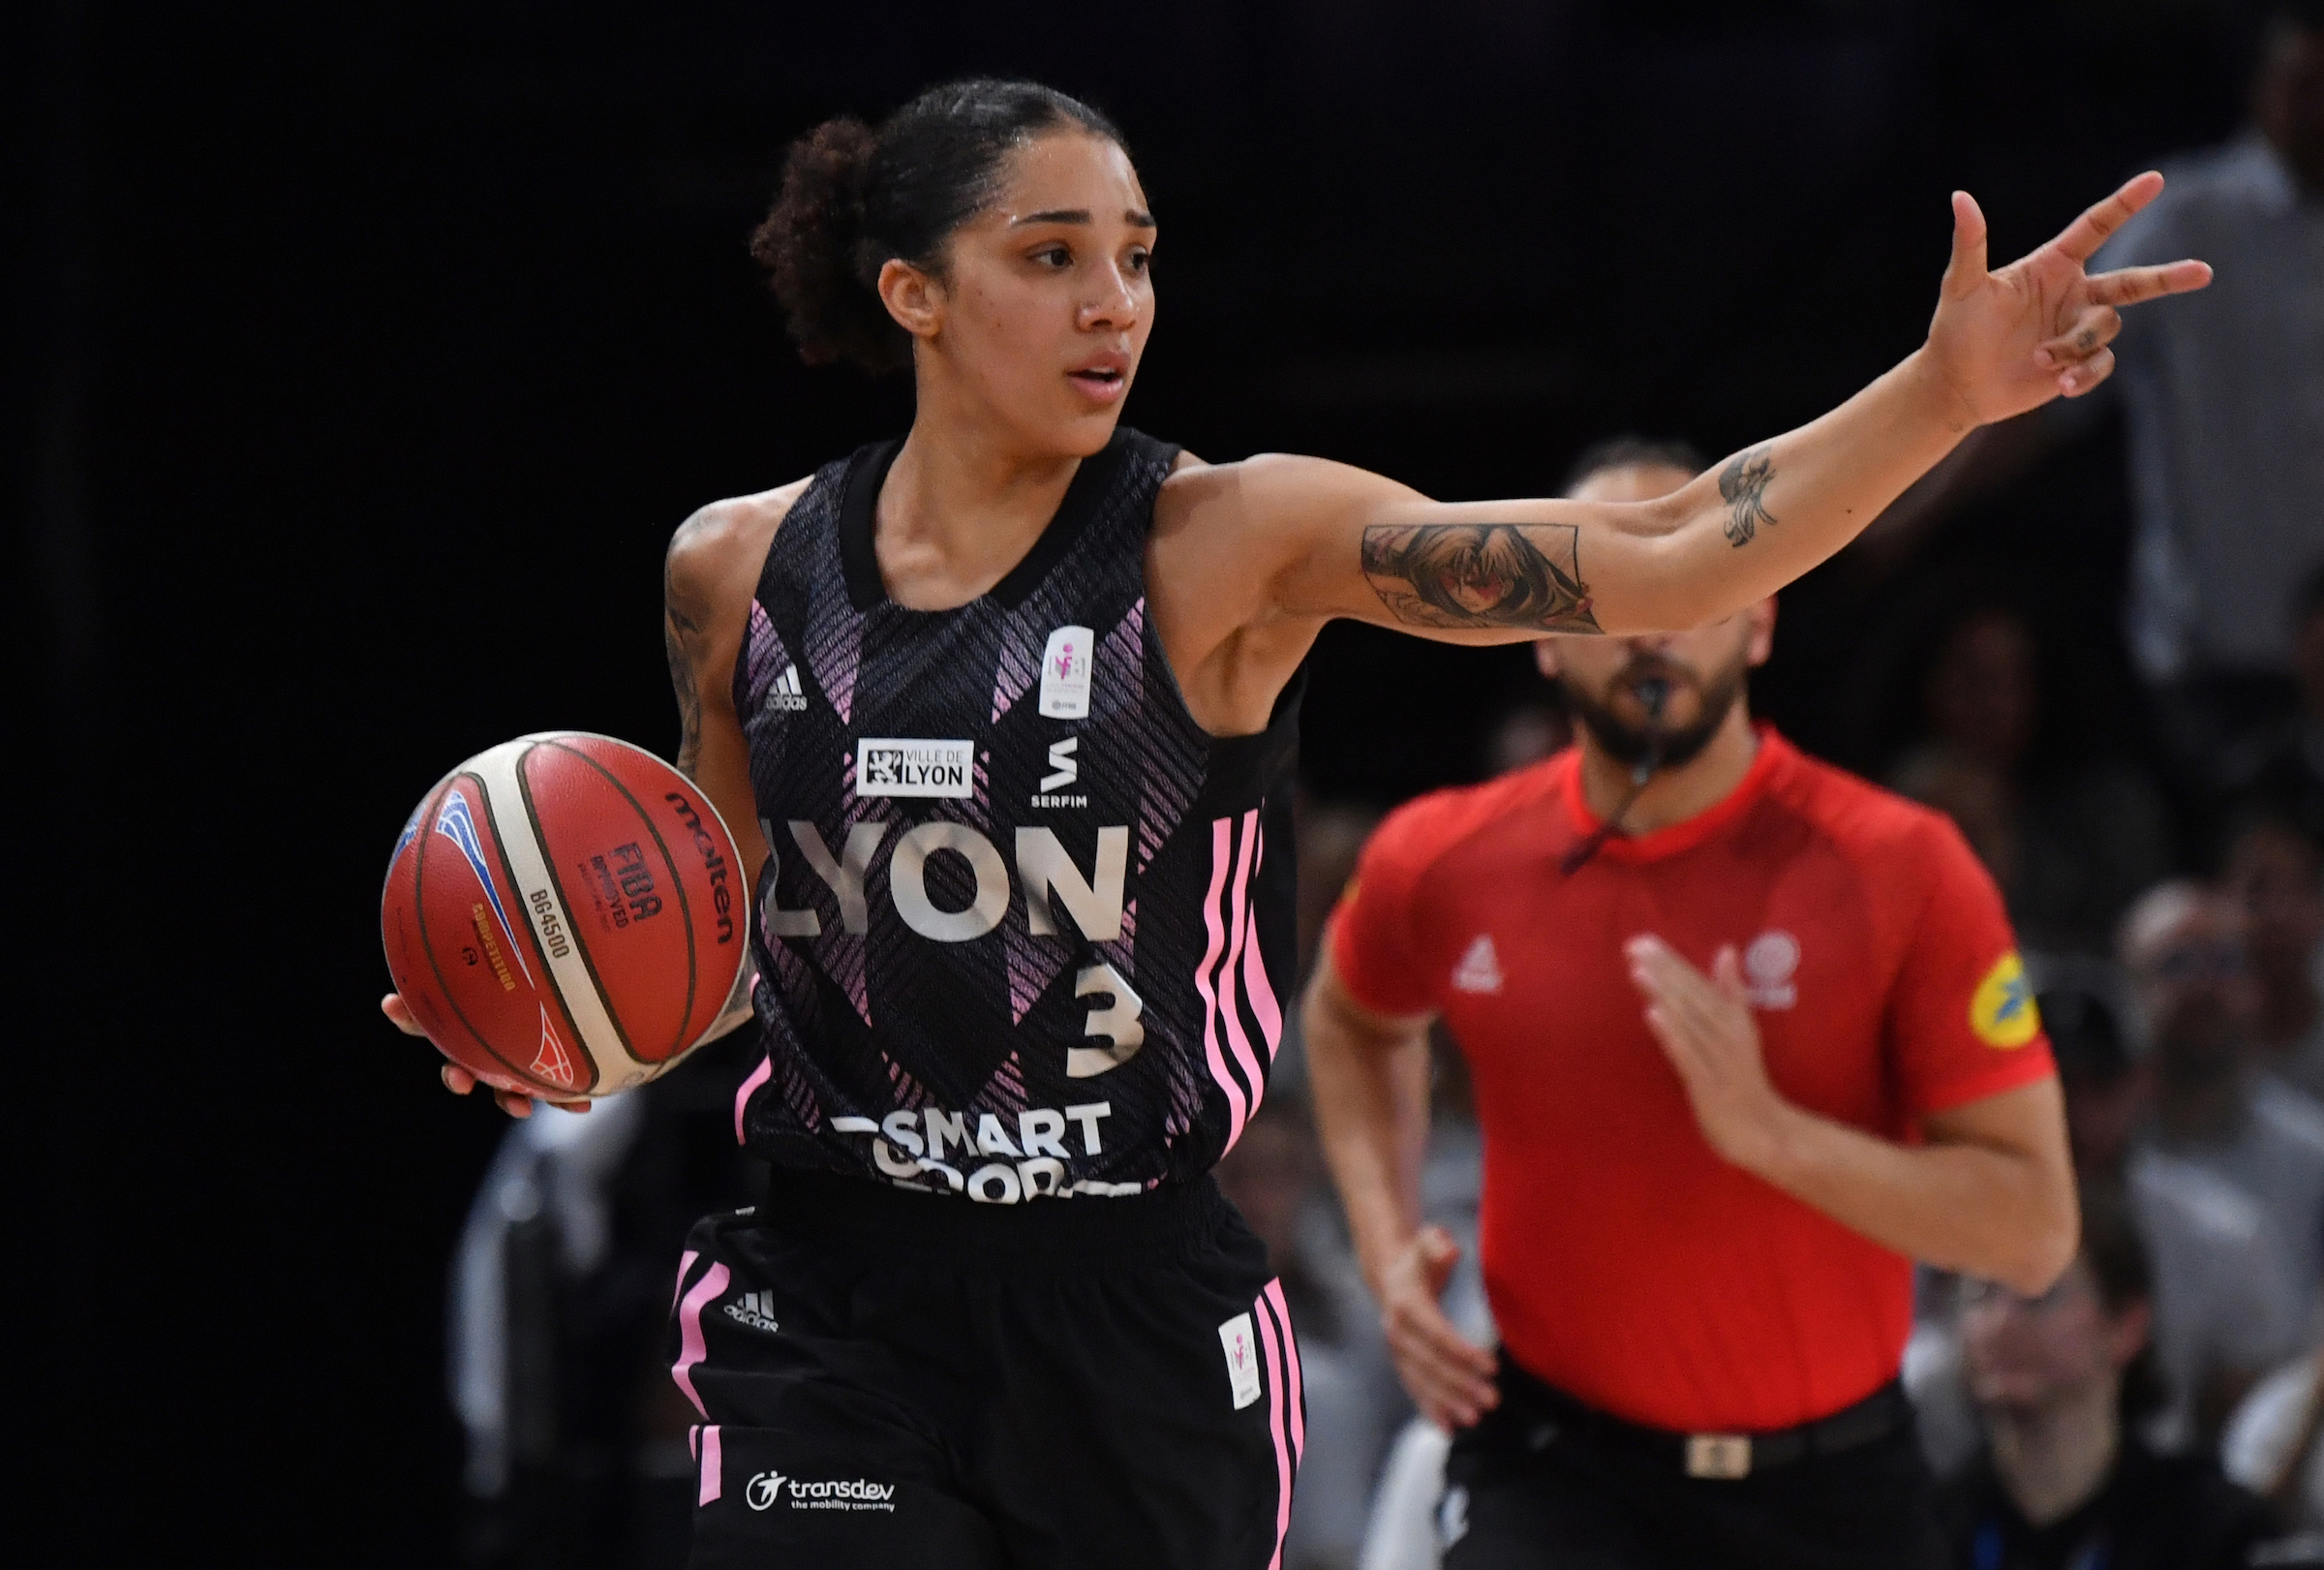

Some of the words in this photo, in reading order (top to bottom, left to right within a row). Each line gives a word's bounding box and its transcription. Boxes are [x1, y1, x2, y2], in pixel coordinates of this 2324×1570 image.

[766, 693, 808, 712] adidas
[906, 750, 941, 763] VILLE
[946, 751, 963, 763] DE
[905, 765, 963, 785] LYON
[1031, 795, 1087, 809] SERFIM
[608, 842, 662, 922] FIBA
[665, 792, 733, 944] molten
[759, 818, 1129, 942] LYON
[531, 889, 569, 958] BG4500
[1066, 962, 1145, 1079] 3
[881, 1101, 1112, 1158] SMART
[723, 1304, 780, 1334] adidas
[788, 1479, 895, 1500] transdev
[791, 1500, 808, 1510] the
[810, 1499, 850, 1511] mobility
[852, 1502, 895, 1513] company
